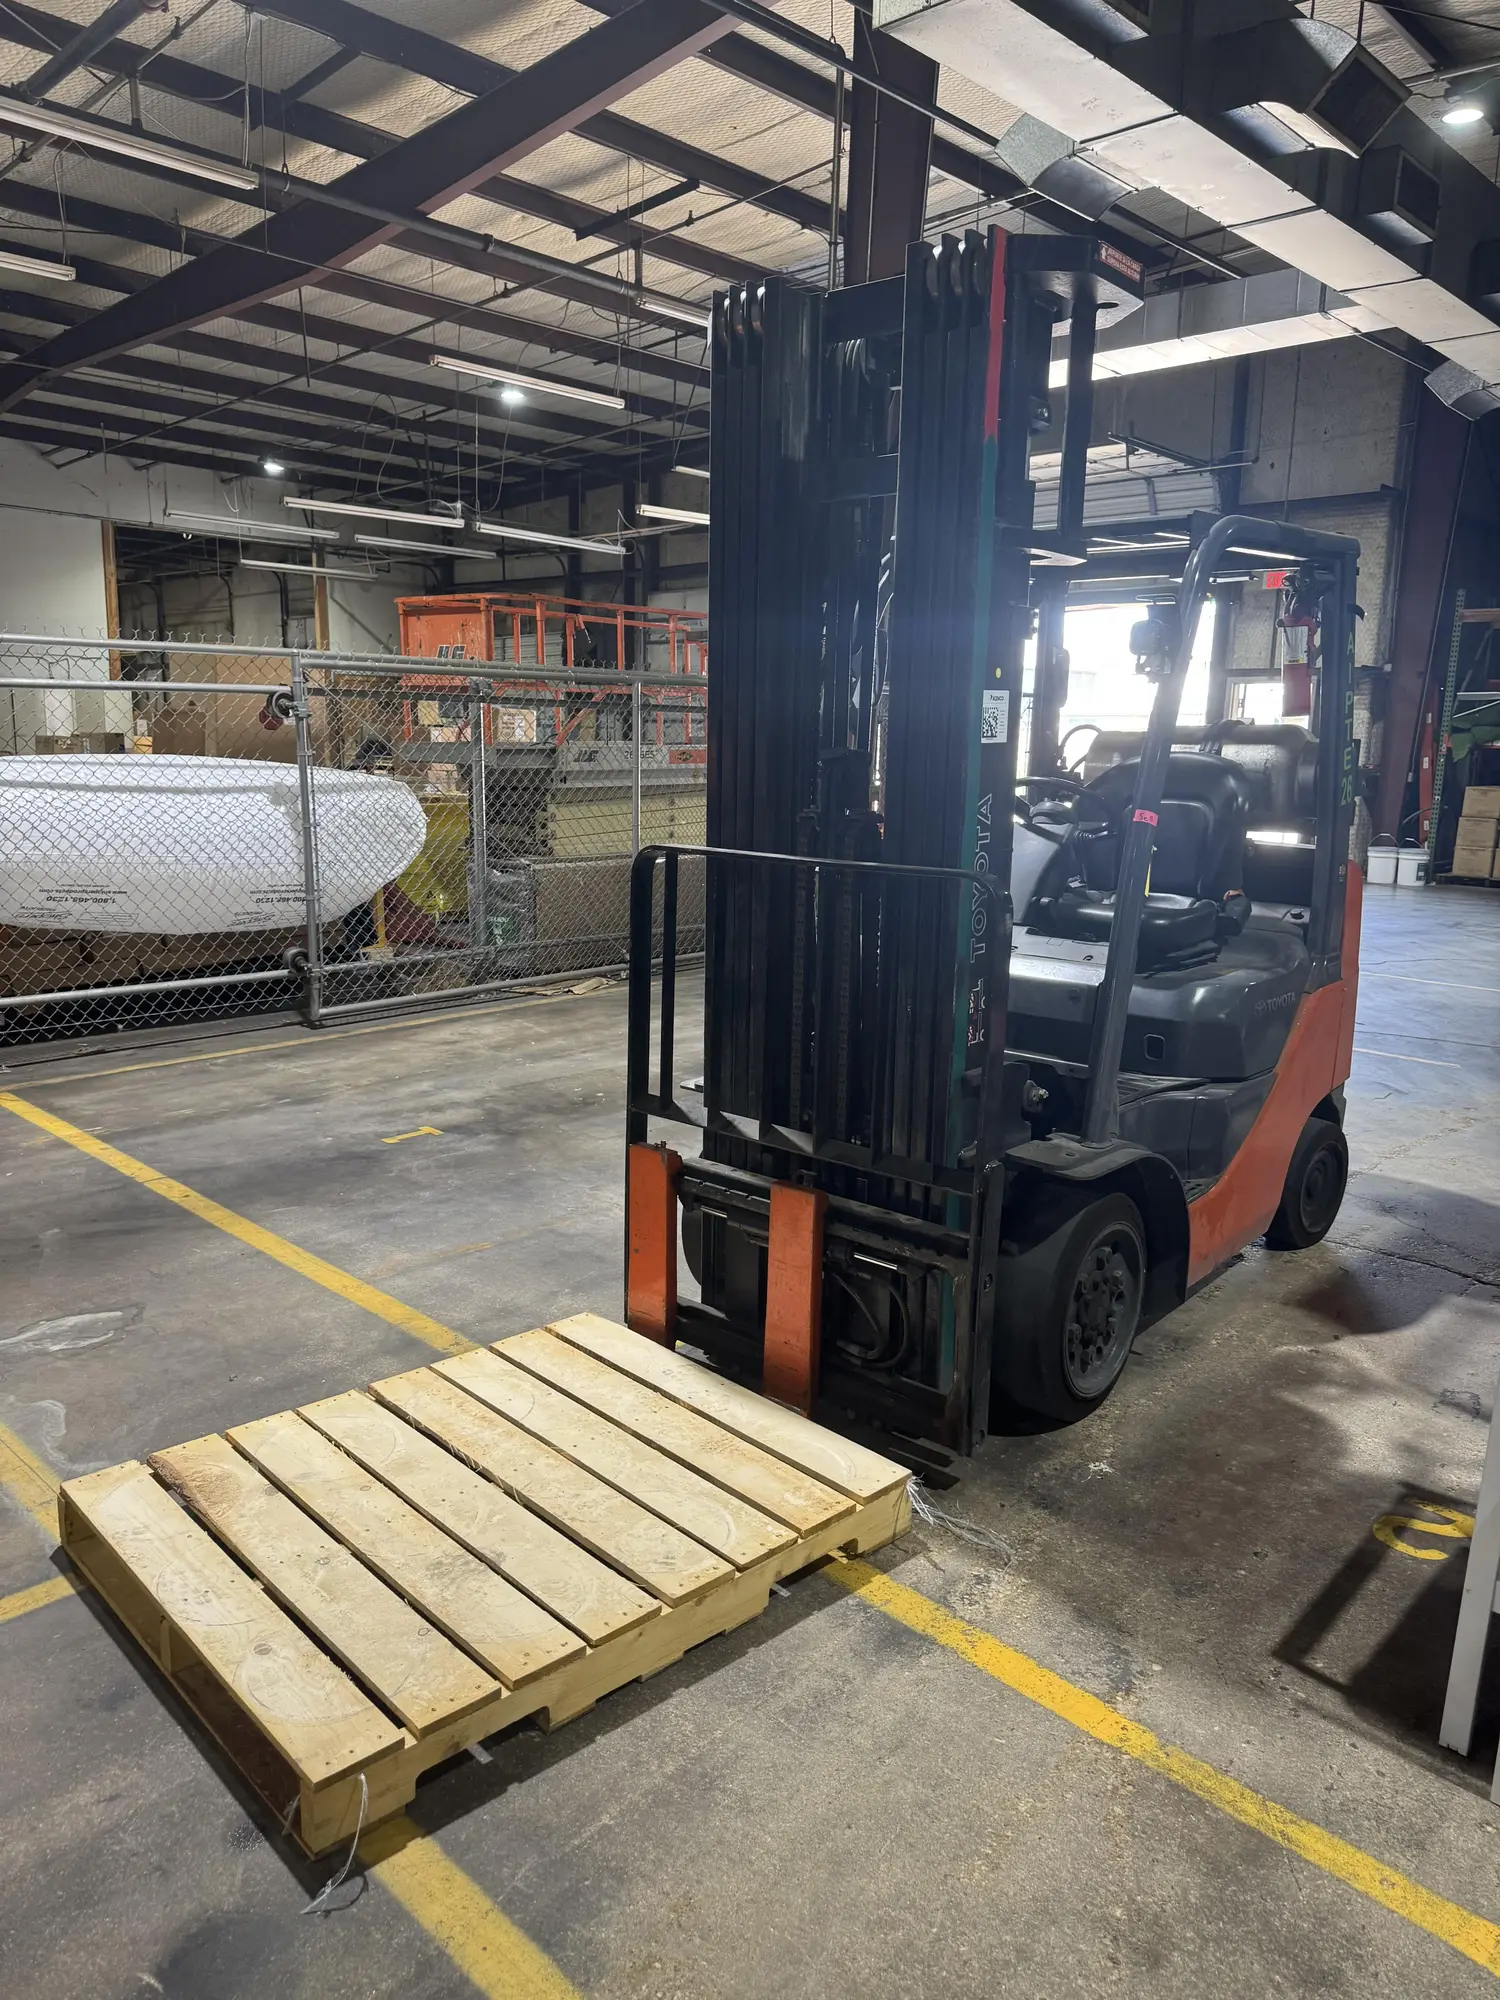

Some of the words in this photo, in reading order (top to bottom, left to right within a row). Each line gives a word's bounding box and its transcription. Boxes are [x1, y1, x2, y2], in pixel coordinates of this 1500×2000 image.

[573, 749, 599, 763] JLG
[970, 793, 993, 964] TOYOTA
[1266, 992, 1296, 1012] TOYOTA
